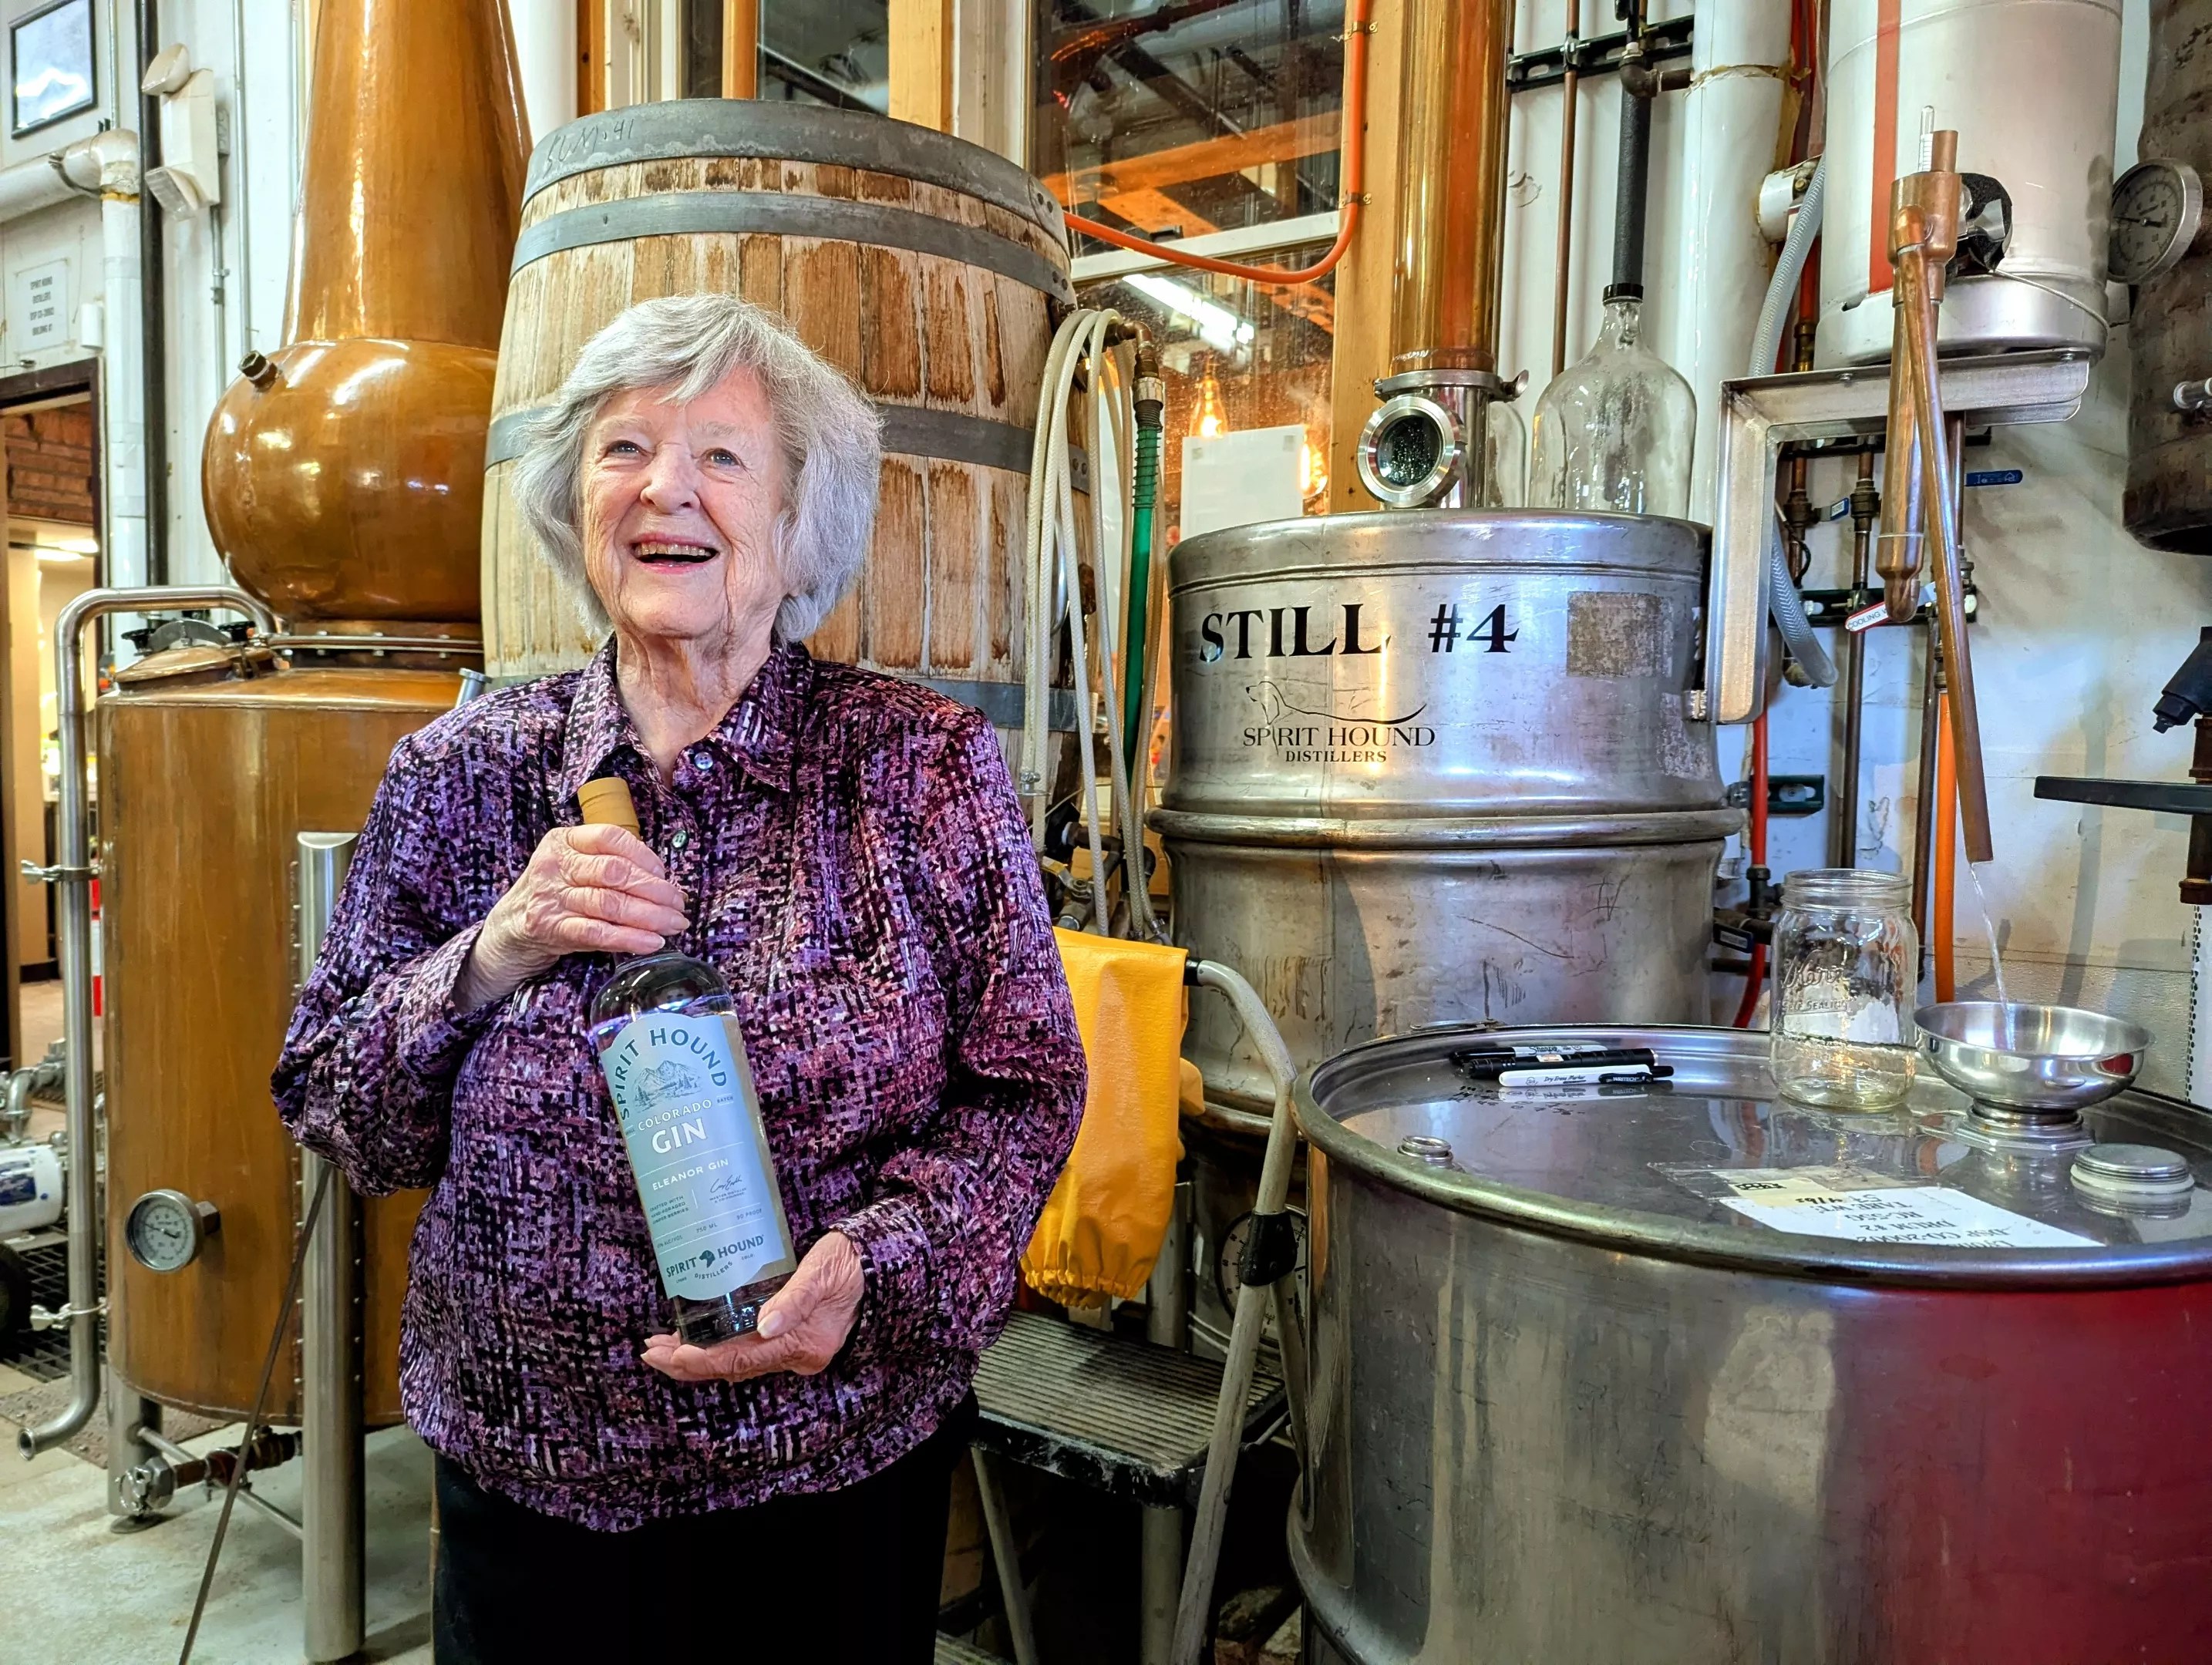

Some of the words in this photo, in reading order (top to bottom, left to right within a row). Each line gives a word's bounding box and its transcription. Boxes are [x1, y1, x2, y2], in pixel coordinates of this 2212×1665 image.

[1199, 603, 1391, 663] STILL
[1428, 603, 1520, 654] #4
[1847, 611, 1881, 630] COOLING
[1243, 726, 1319, 748] SPIRIT
[1328, 726, 1436, 747] HOUND
[1284, 750, 1387, 763] DISTILLERS
[615, 1038, 639, 1121] SPIRIT
[649, 1028, 727, 1087] HOUND
[638, 1099, 712, 1132] COLORADO
[651, 1118, 708, 1154] GIN
[652, 1166, 704, 1191] ELEANOR
[708, 1158, 729, 1171] GIN
[668, 1195, 685, 1204] WITH
[1890, 1219, 1957, 1230] DRUM
[665, 1256, 697, 1278] SPIRIT
[718, 1235, 764, 1259] HOUND
[694, 1260, 733, 1280] DISTILLERS
